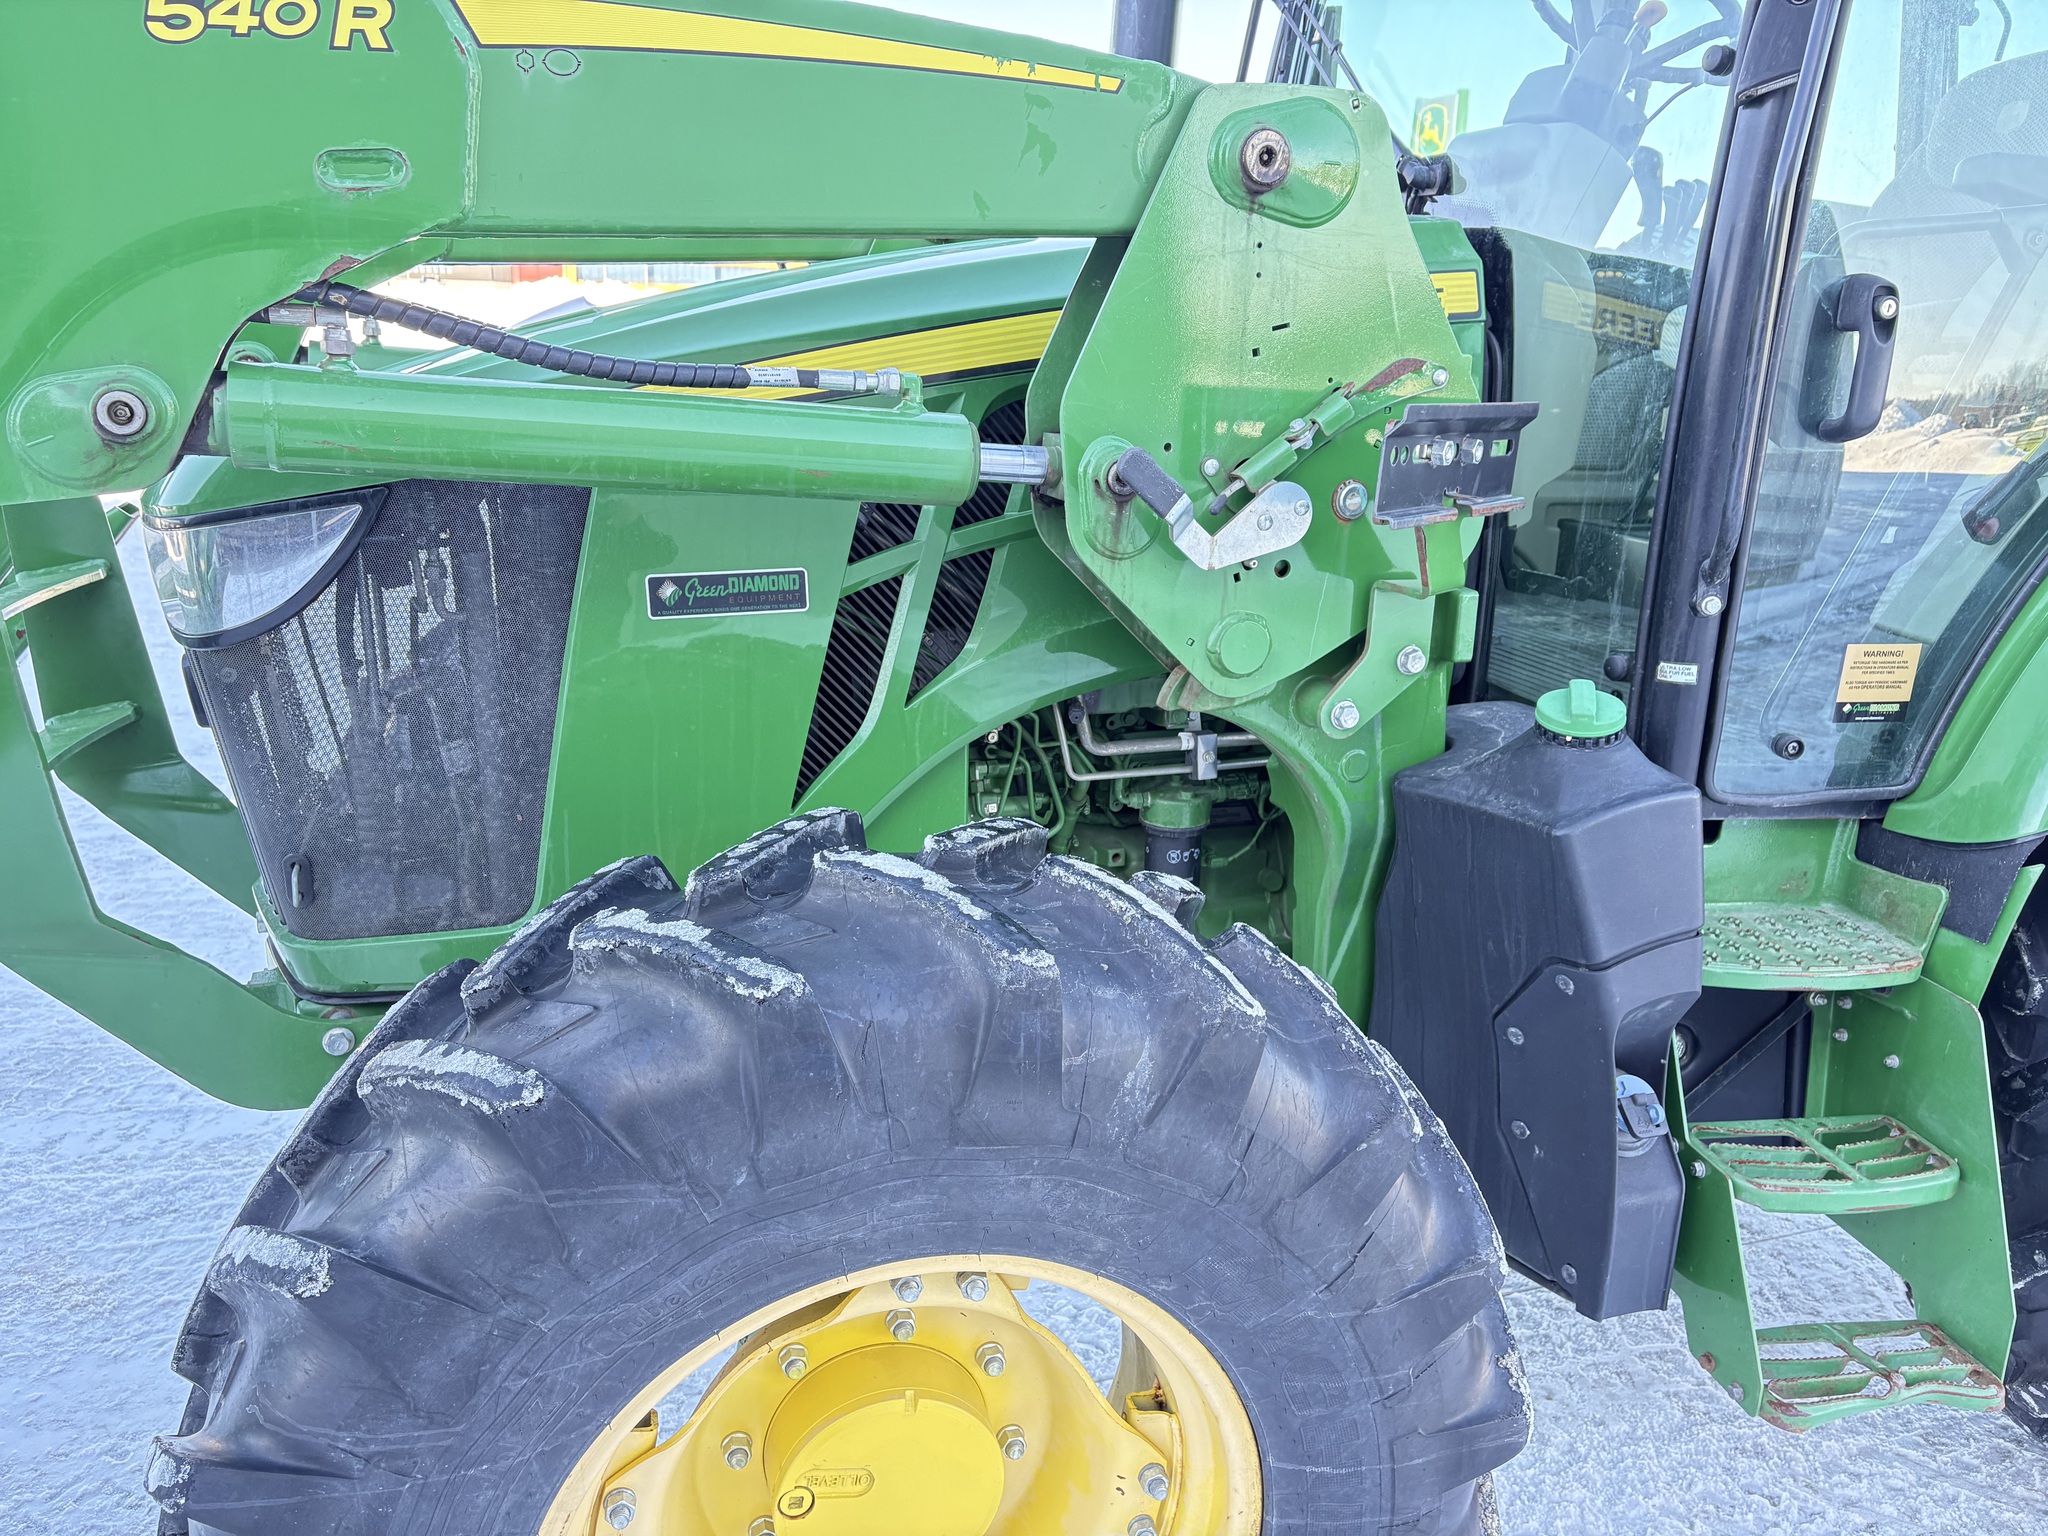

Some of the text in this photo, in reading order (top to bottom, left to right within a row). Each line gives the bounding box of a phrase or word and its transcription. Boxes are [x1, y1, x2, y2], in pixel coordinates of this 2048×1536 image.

[144, 0, 394, 52] 540 R
[684, 574, 800, 606] Green DIAMOND
[729, 593, 801, 604] EQUIPMENT
[1863, 650, 1904, 658] WARNING!
[850, 1473, 871, 1487] OIL
